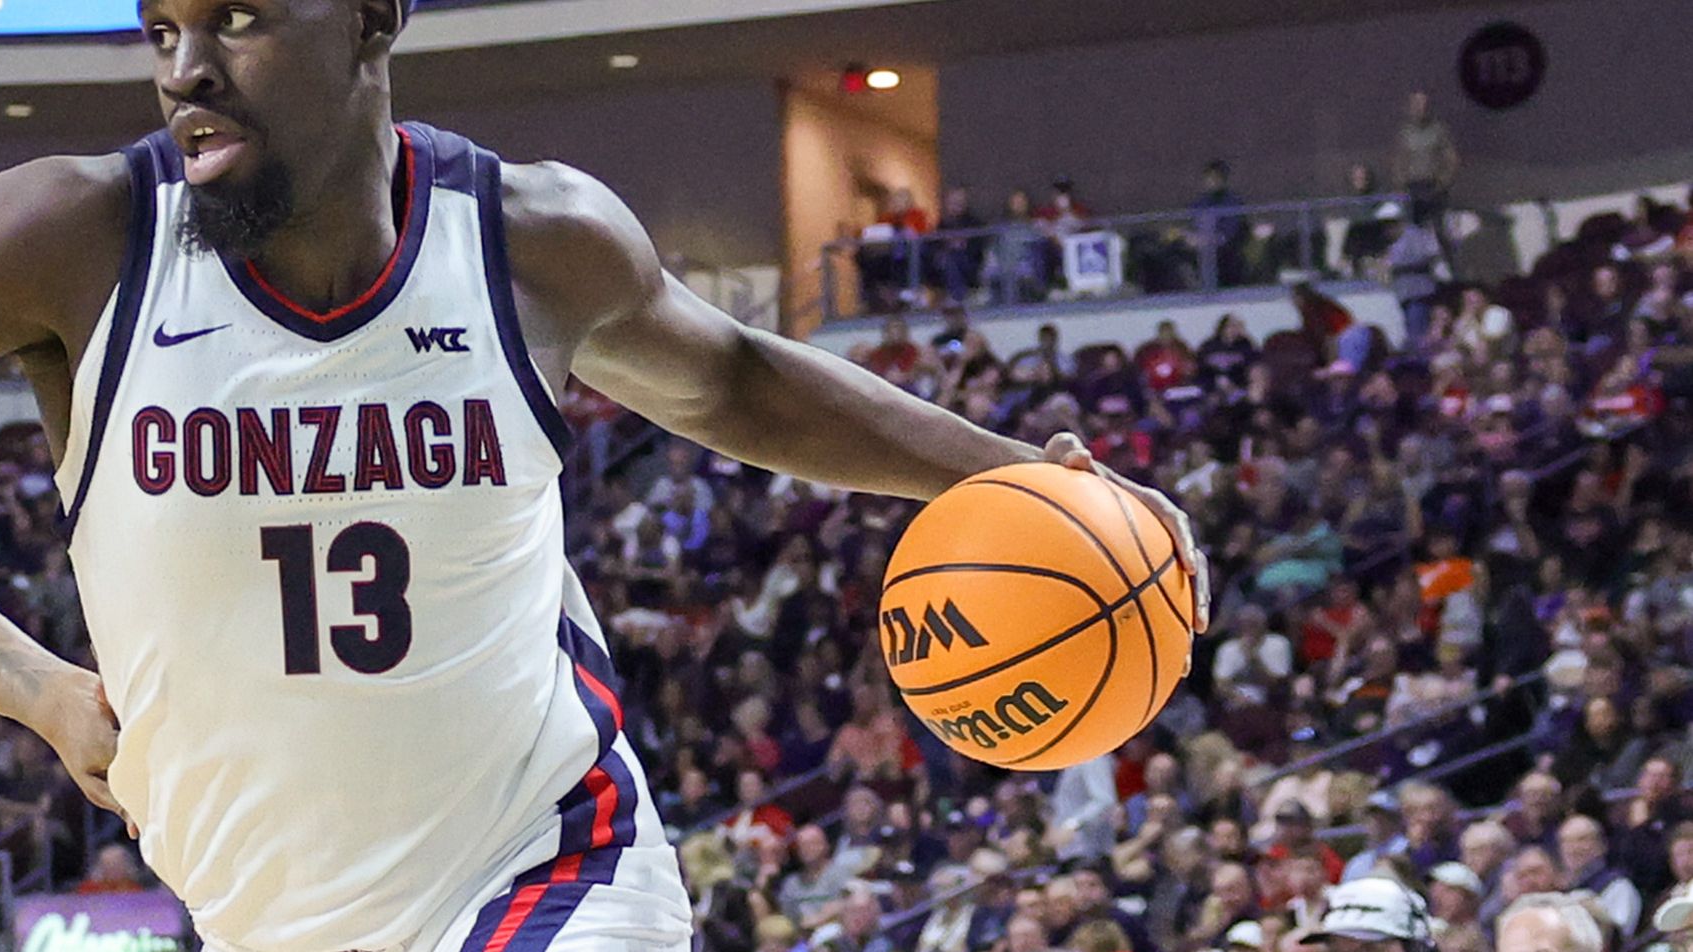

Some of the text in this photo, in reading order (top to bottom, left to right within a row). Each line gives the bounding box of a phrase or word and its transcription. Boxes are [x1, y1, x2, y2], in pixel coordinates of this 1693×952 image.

[404, 326, 471, 355] WCC
[131, 398, 508, 497] GONZAGA
[259, 520, 413, 676] 13
